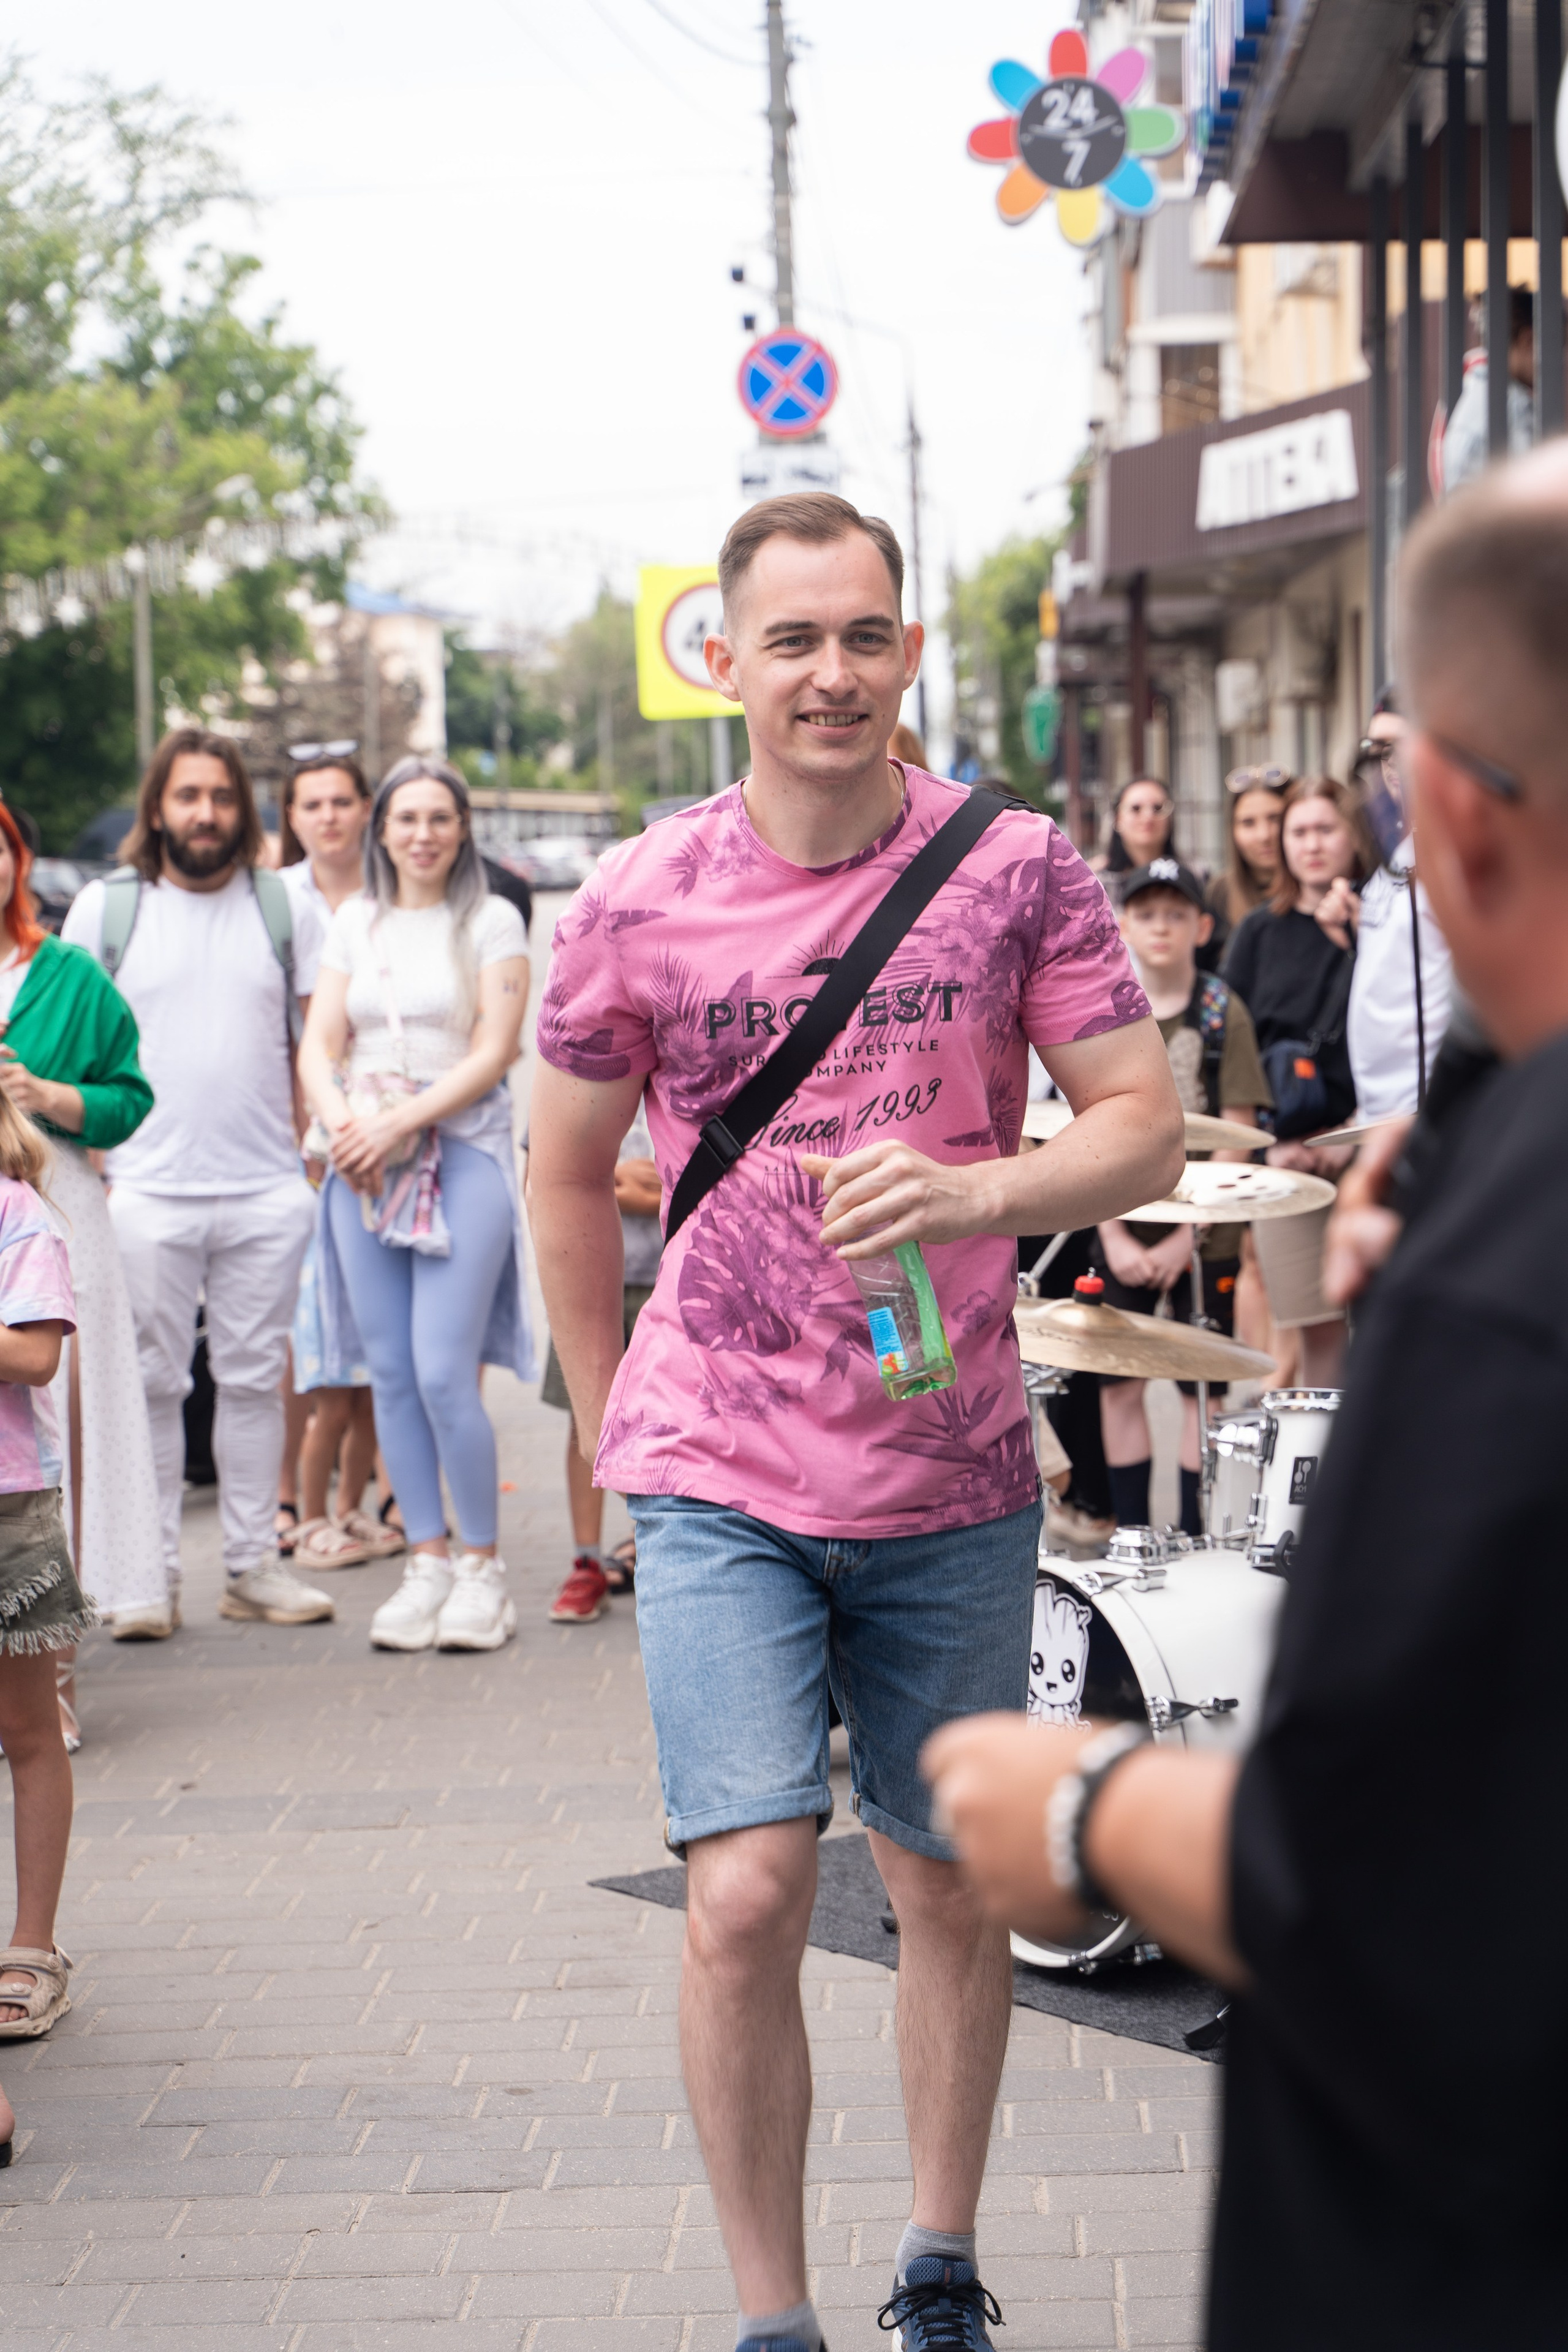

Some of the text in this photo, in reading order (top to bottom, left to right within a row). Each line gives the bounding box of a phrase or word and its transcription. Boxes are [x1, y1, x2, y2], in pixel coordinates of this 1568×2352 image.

[1041, 86, 1099, 129] 24
[1061, 140, 1091, 183] 7
[684, 616, 724, 653] 4
[703, 982, 962, 1039] PROEST
[728, 1054, 772, 1068] SUR
[834, 1039, 939, 1060] LIFESTYLE
[807, 1060, 886, 1078] MPANY
[745, 1077, 942, 1150] Since 1993
